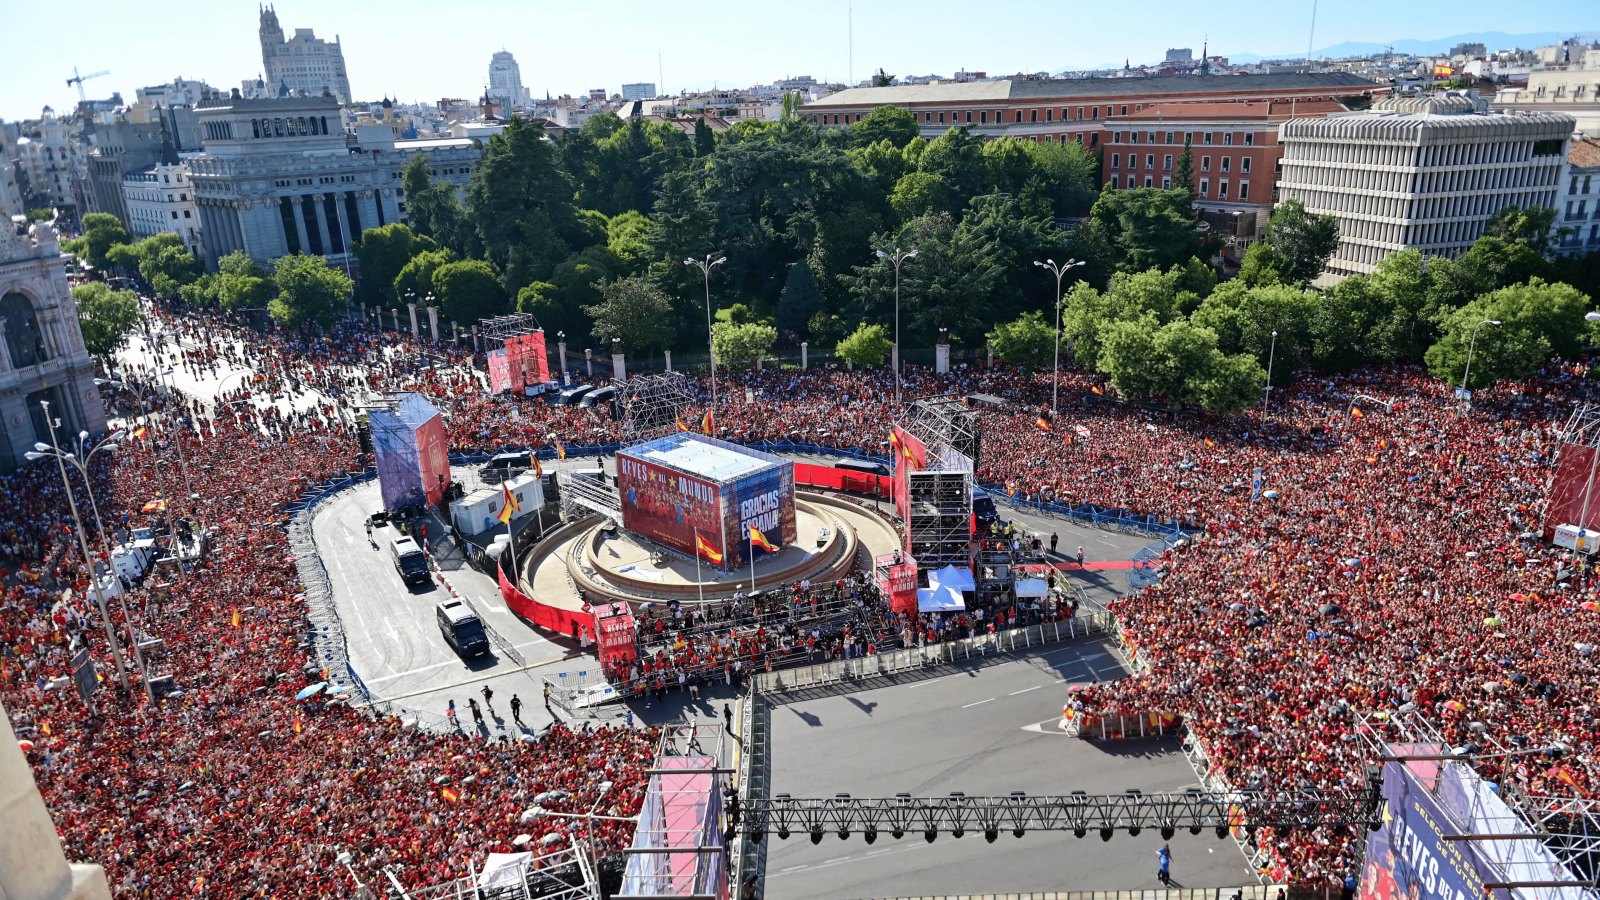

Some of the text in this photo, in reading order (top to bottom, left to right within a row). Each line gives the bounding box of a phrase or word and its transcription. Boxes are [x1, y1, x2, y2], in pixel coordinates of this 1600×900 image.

[622, 458, 714, 504] REYES DEL MUNDO
[894, 570, 912, 579] REYES
[893, 582, 914, 592] MUNDO
[607, 622, 628, 633] REYES
[607, 635, 632, 647] MUNDO
[1393, 814, 1439, 895] REYES
[1435, 841, 1448, 858] DE
